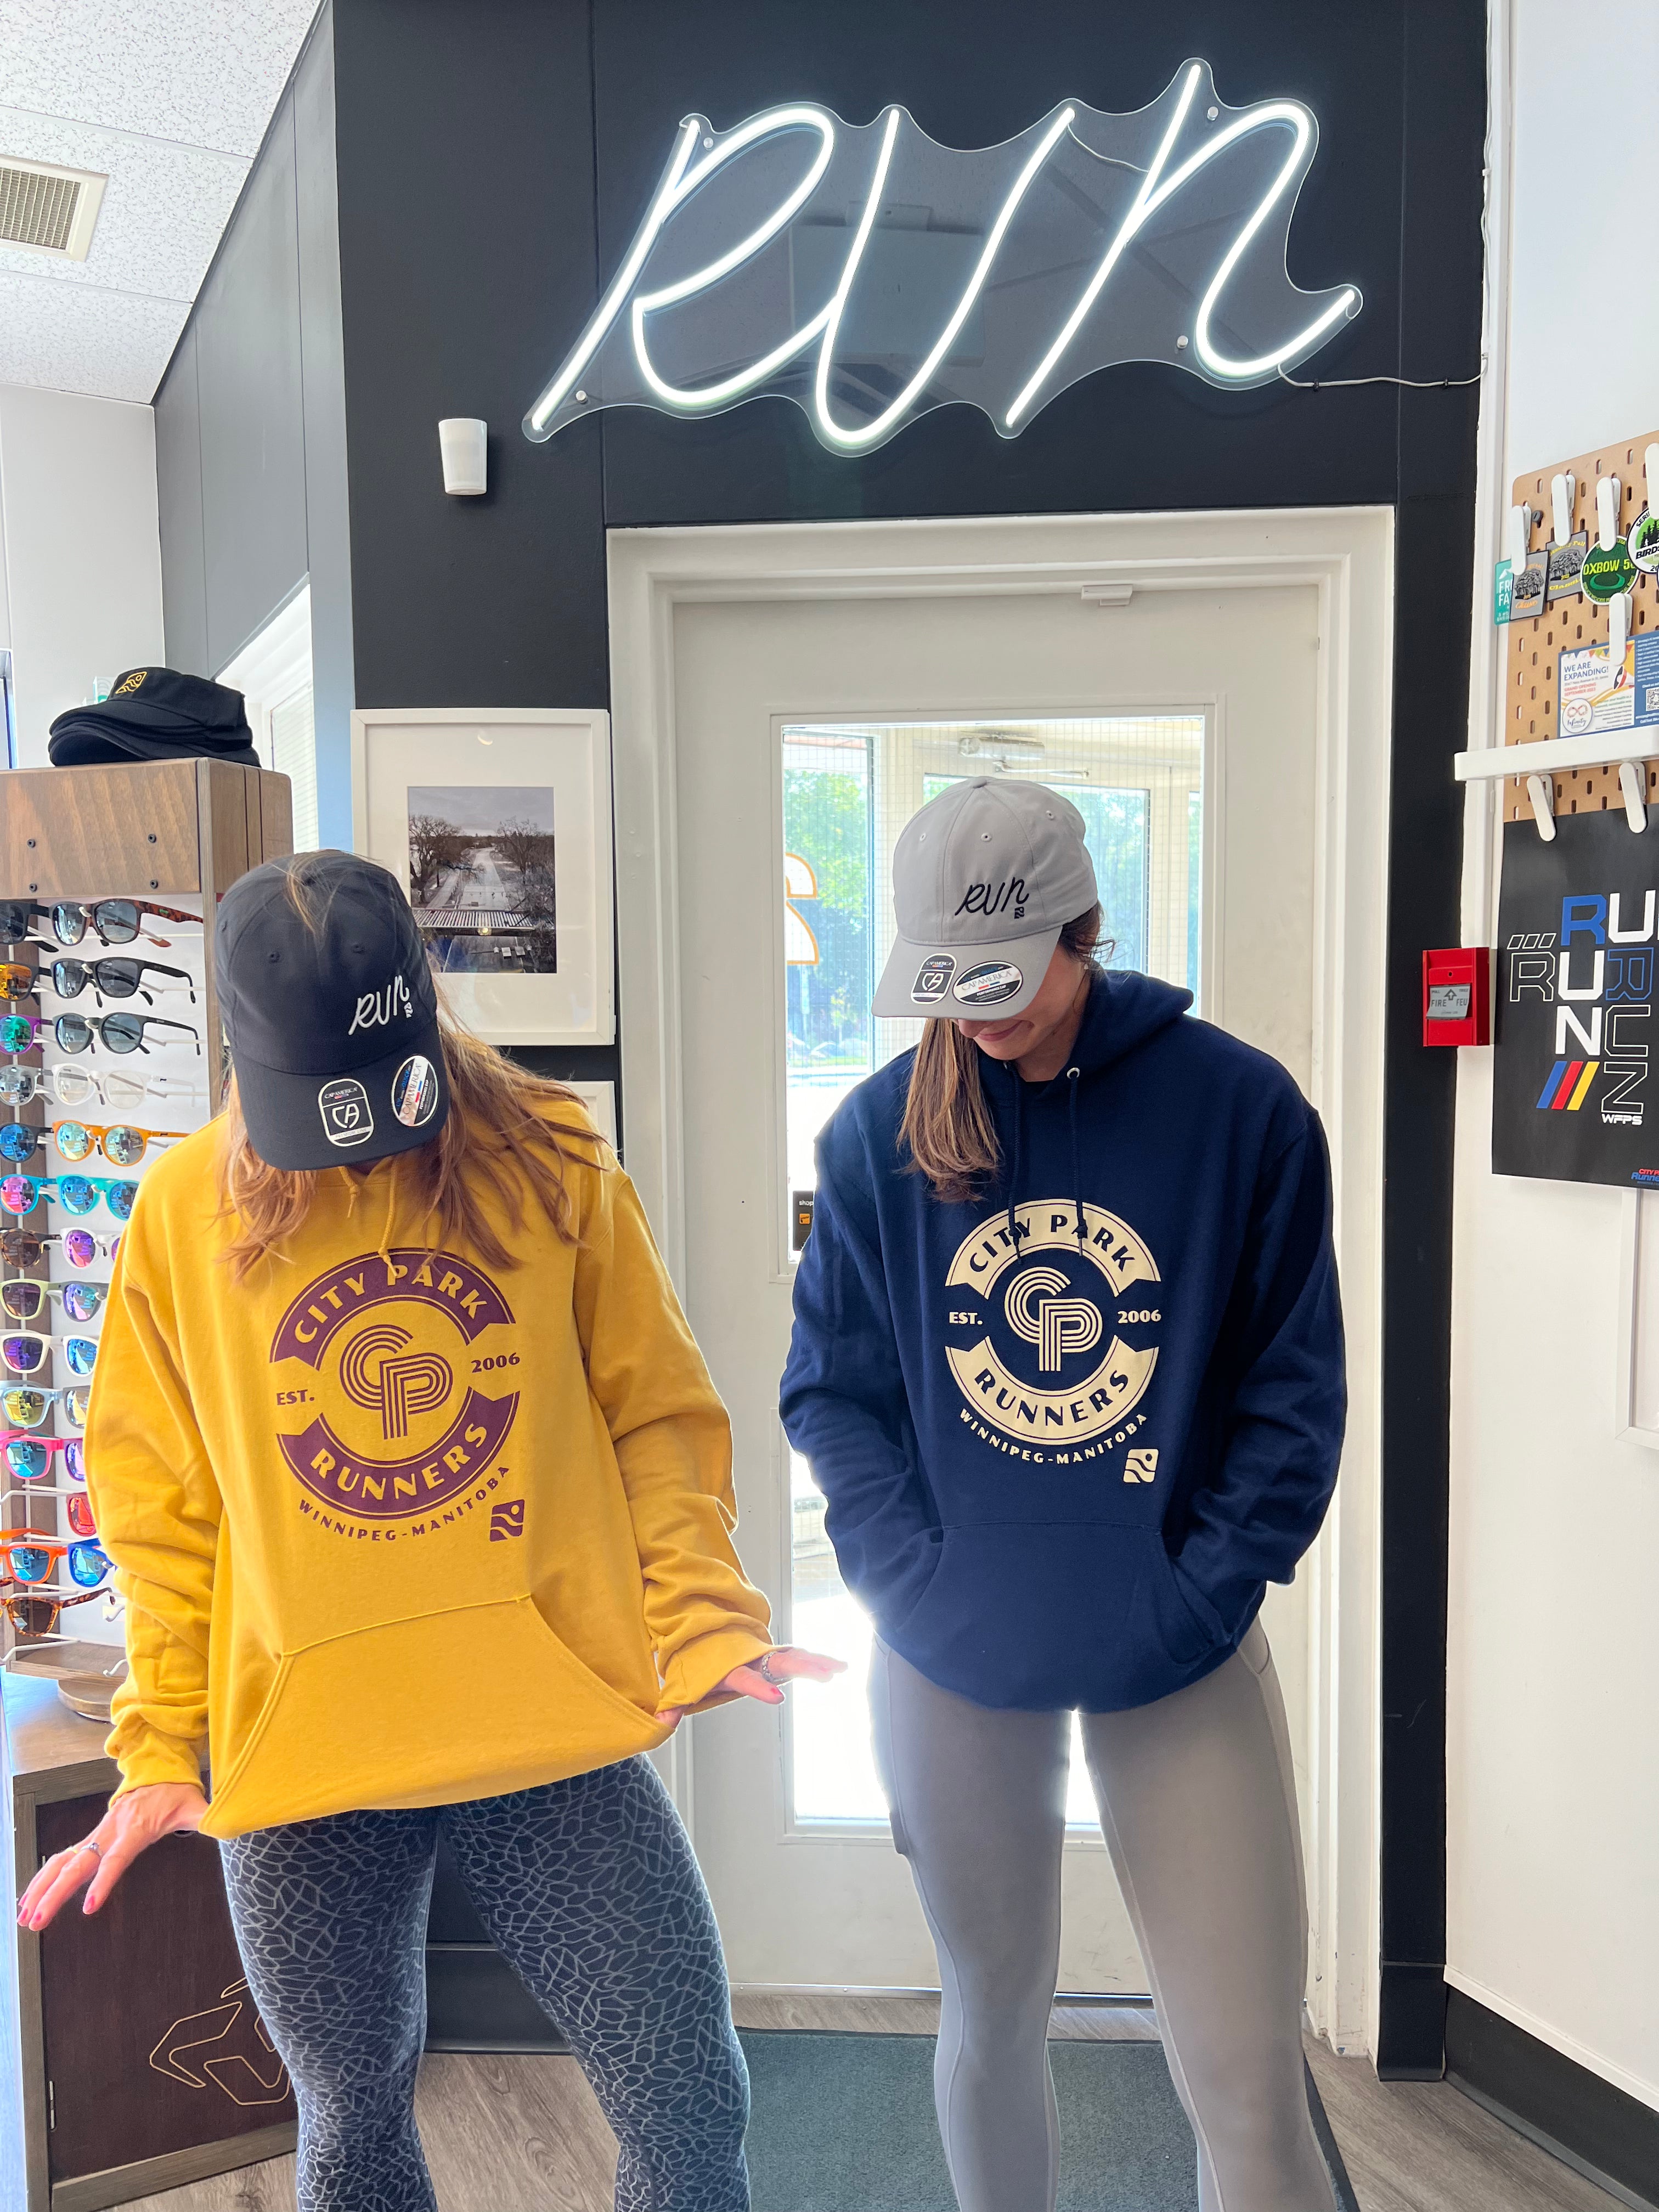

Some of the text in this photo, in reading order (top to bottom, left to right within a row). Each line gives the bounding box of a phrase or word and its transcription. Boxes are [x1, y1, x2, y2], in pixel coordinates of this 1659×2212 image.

[1583, 559, 1620, 575] OXBOW
[1564, 661, 1591, 673] WE ARE
[1564, 666, 1609, 681] EXPANDING!
[1431, 998, 1468, 1007] FIRE FEU
[1601, 1113, 1643, 1125] WFPS
[969, 1214, 1135, 1272] CITY PARK
[295, 1263, 488, 1344] CITY PARK
[949, 1308, 1161, 1325] EST. 2006
[471, 1352, 521, 1373] 2006
[276, 1389, 315, 1406] EST.
[974, 1367, 1128, 1426] RUNNERS
[309, 1423, 487, 1500] RUNNERS
